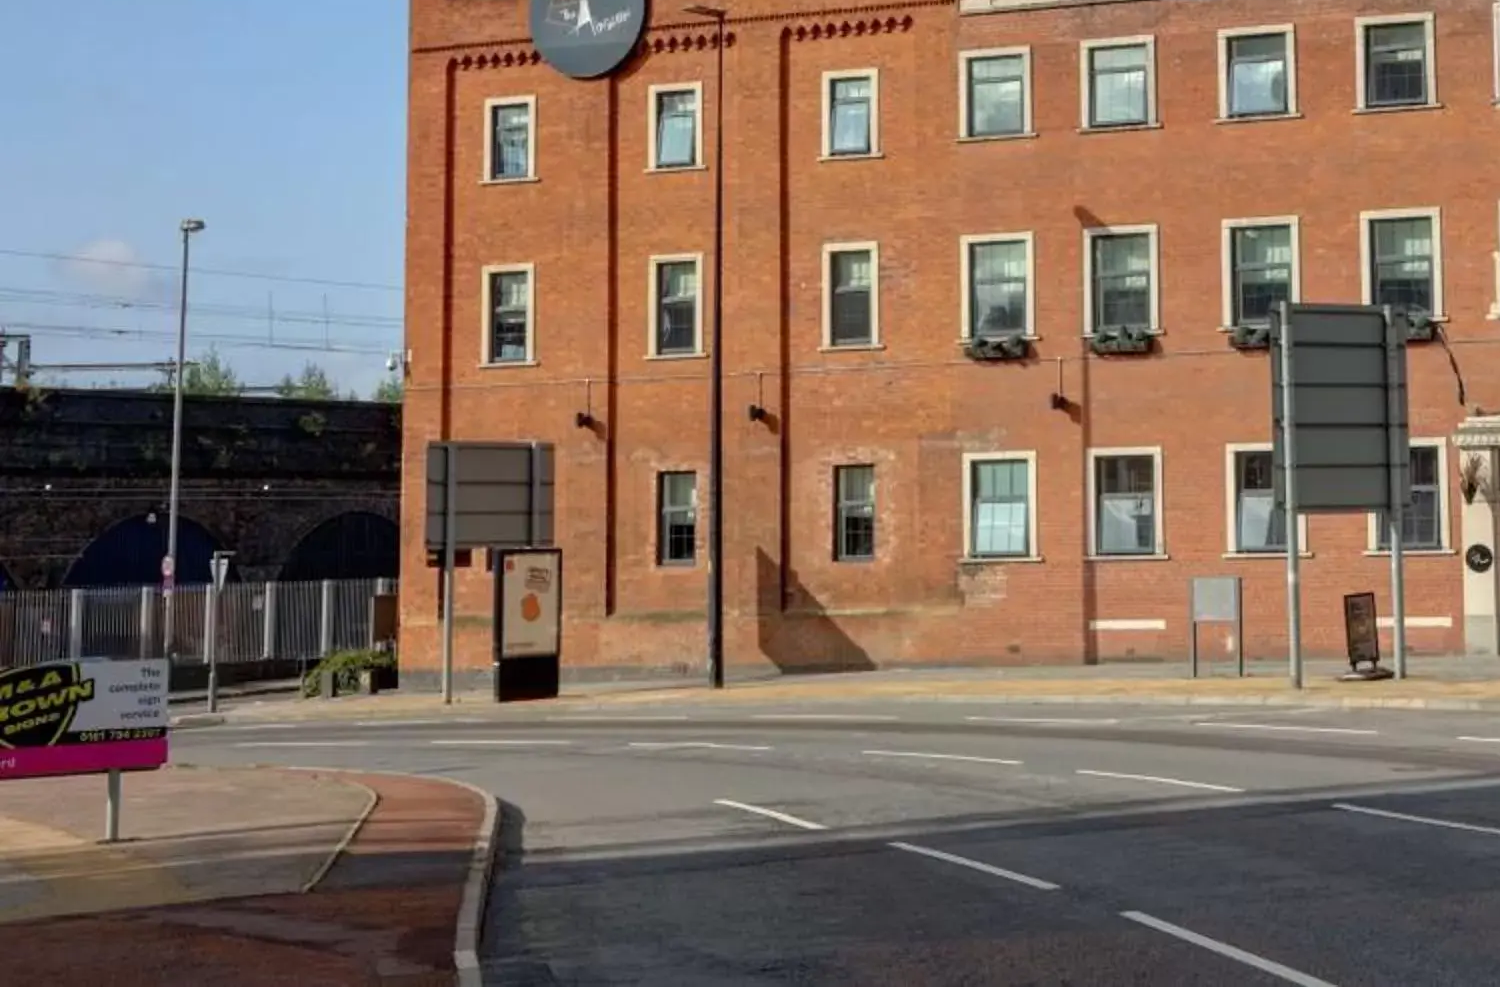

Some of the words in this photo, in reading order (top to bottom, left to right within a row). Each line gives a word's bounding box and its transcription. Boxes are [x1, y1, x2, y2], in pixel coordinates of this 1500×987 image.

[141, 666, 160, 677] The
[109, 682, 160, 693] complete
[138, 695, 160, 706] sign
[121, 710, 159, 719] service
